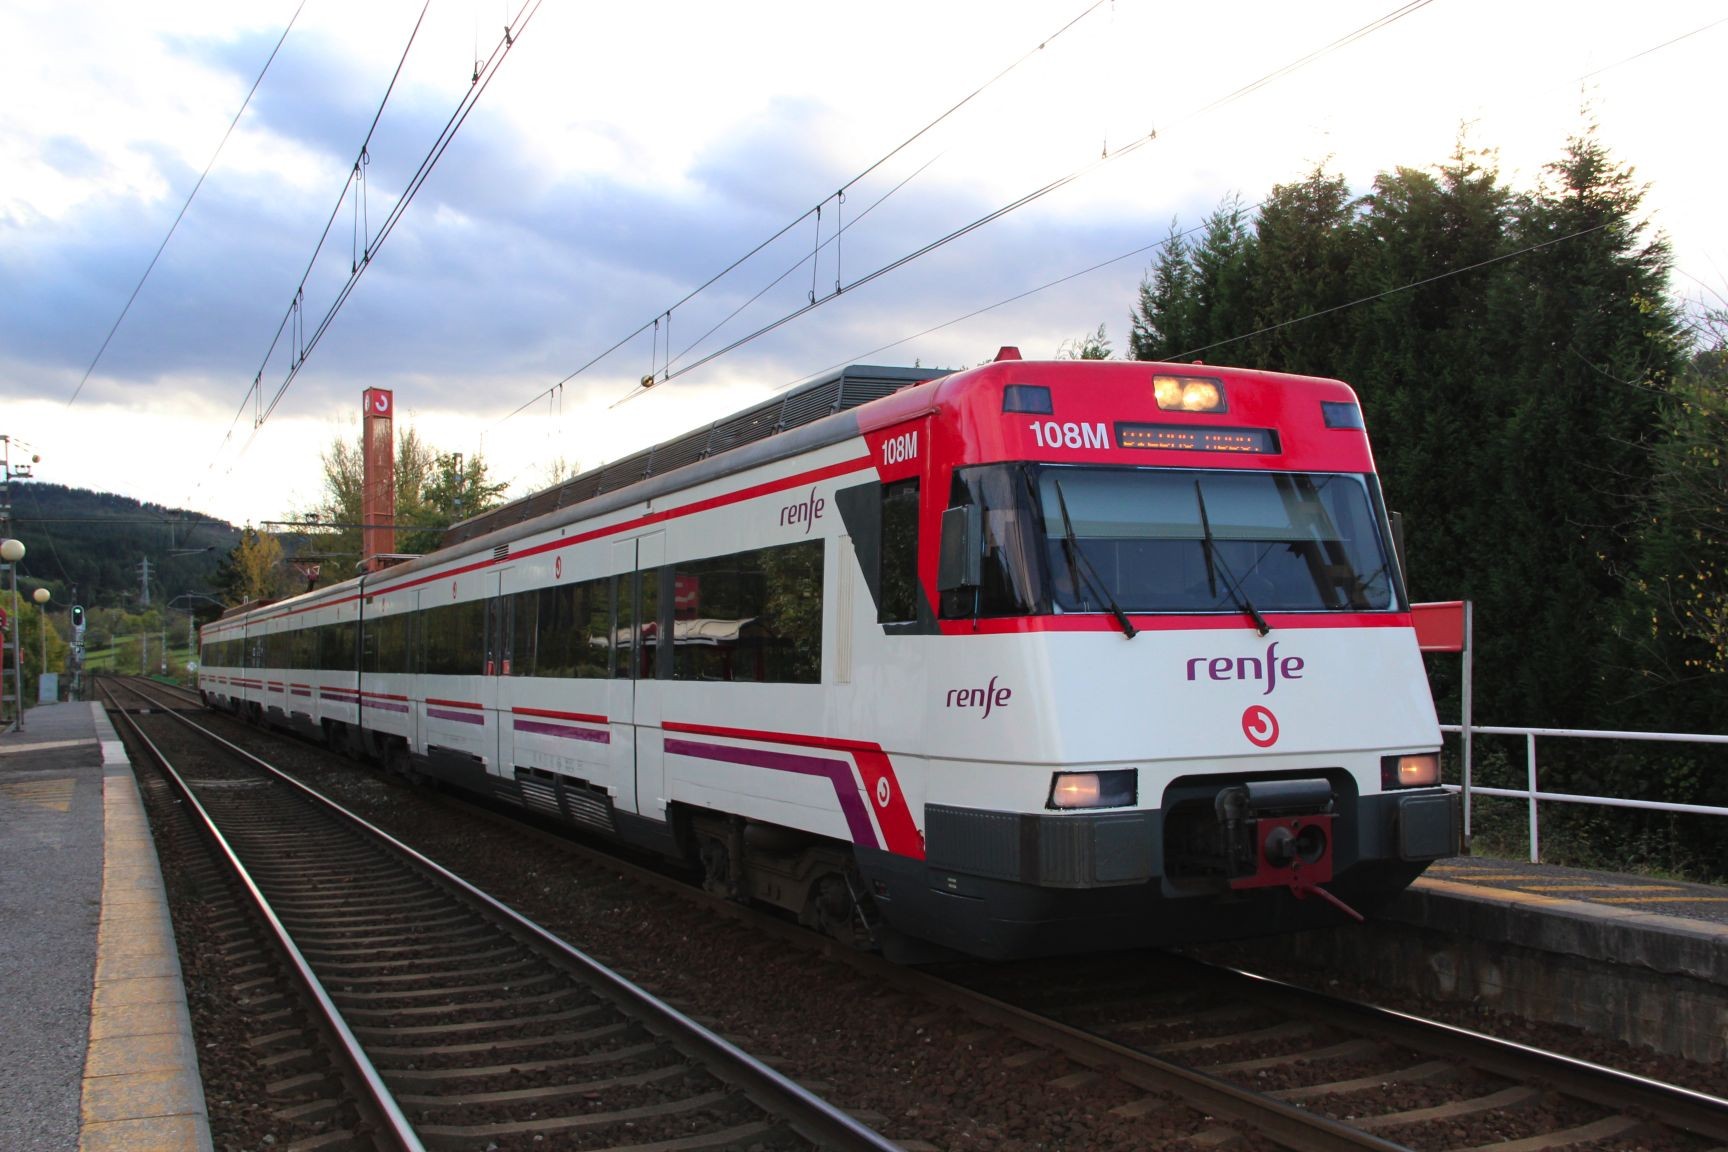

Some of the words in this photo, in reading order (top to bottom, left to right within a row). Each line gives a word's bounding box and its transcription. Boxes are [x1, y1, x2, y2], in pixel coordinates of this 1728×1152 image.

[881, 431, 918, 466] 108M
[1029, 421, 1110, 450] 108M
[780, 486, 825, 535] renfe
[1186, 641, 1305, 696] renfe
[946, 675, 1012, 719] renfe
